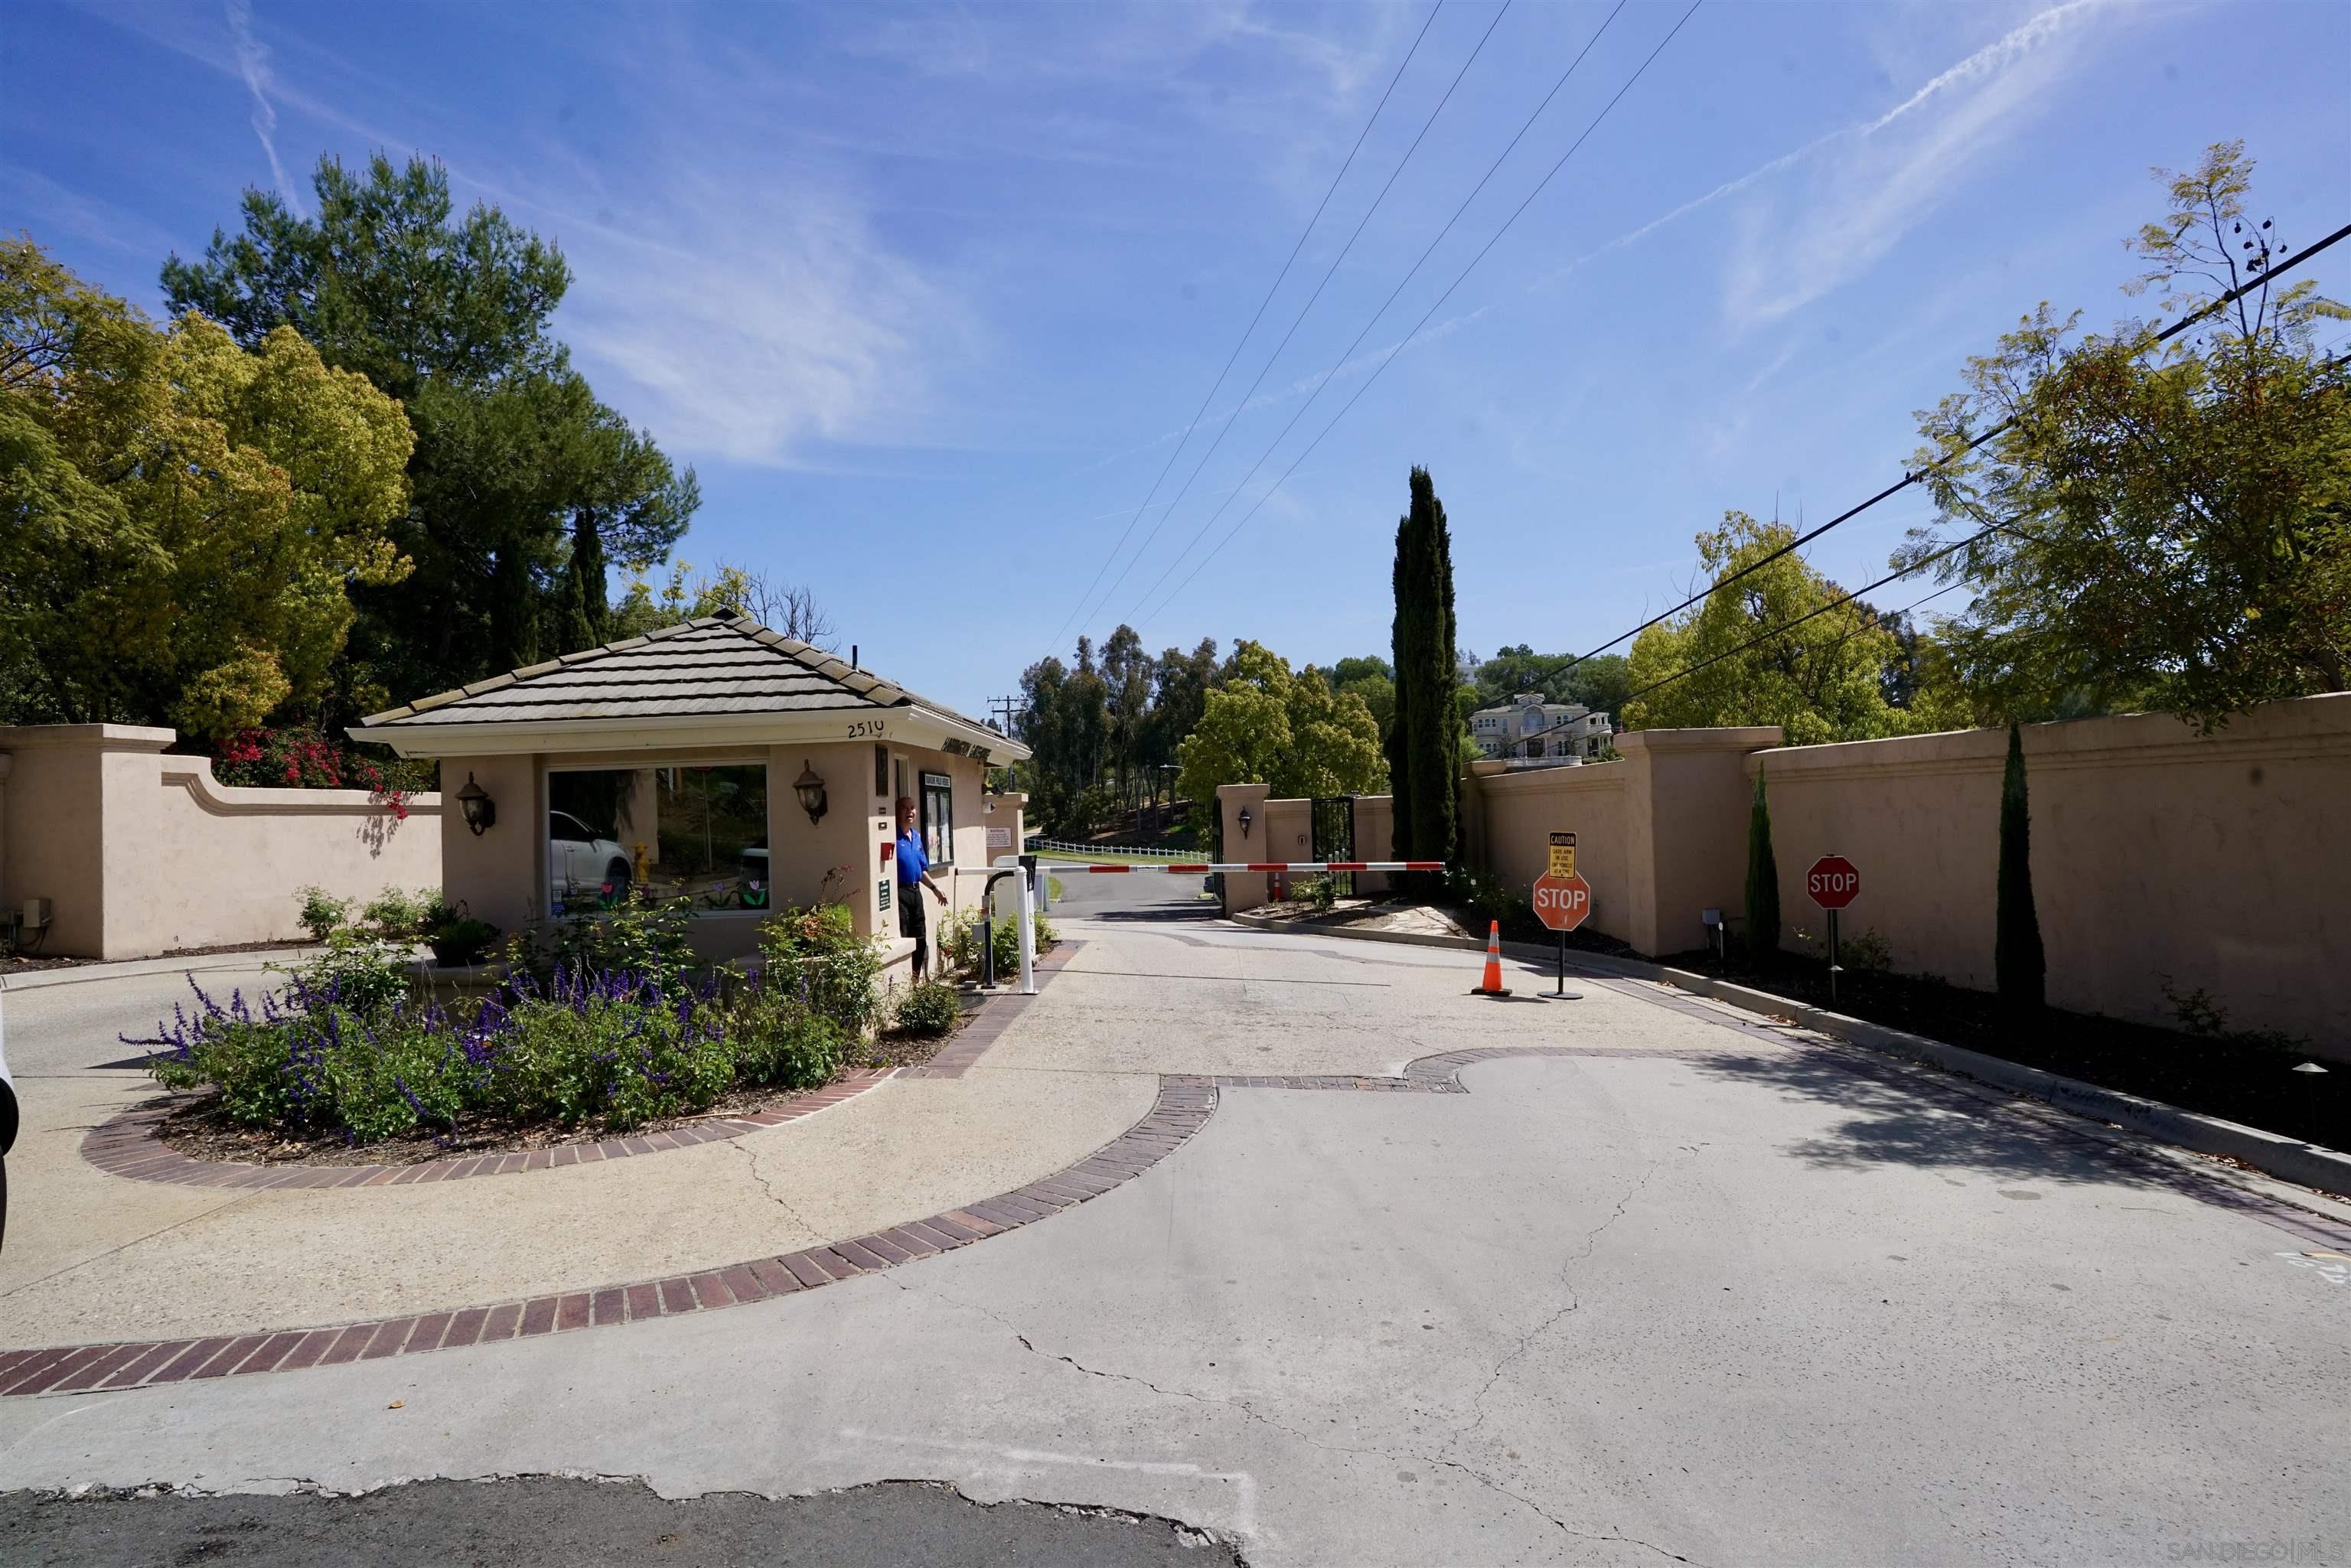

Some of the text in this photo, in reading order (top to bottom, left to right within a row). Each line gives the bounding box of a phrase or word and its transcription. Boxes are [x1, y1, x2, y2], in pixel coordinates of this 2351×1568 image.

[1550, 835, 1575, 845] CAUTION
[1811, 873, 1857, 892] STOP
[1537, 888, 1586, 910] STOP
